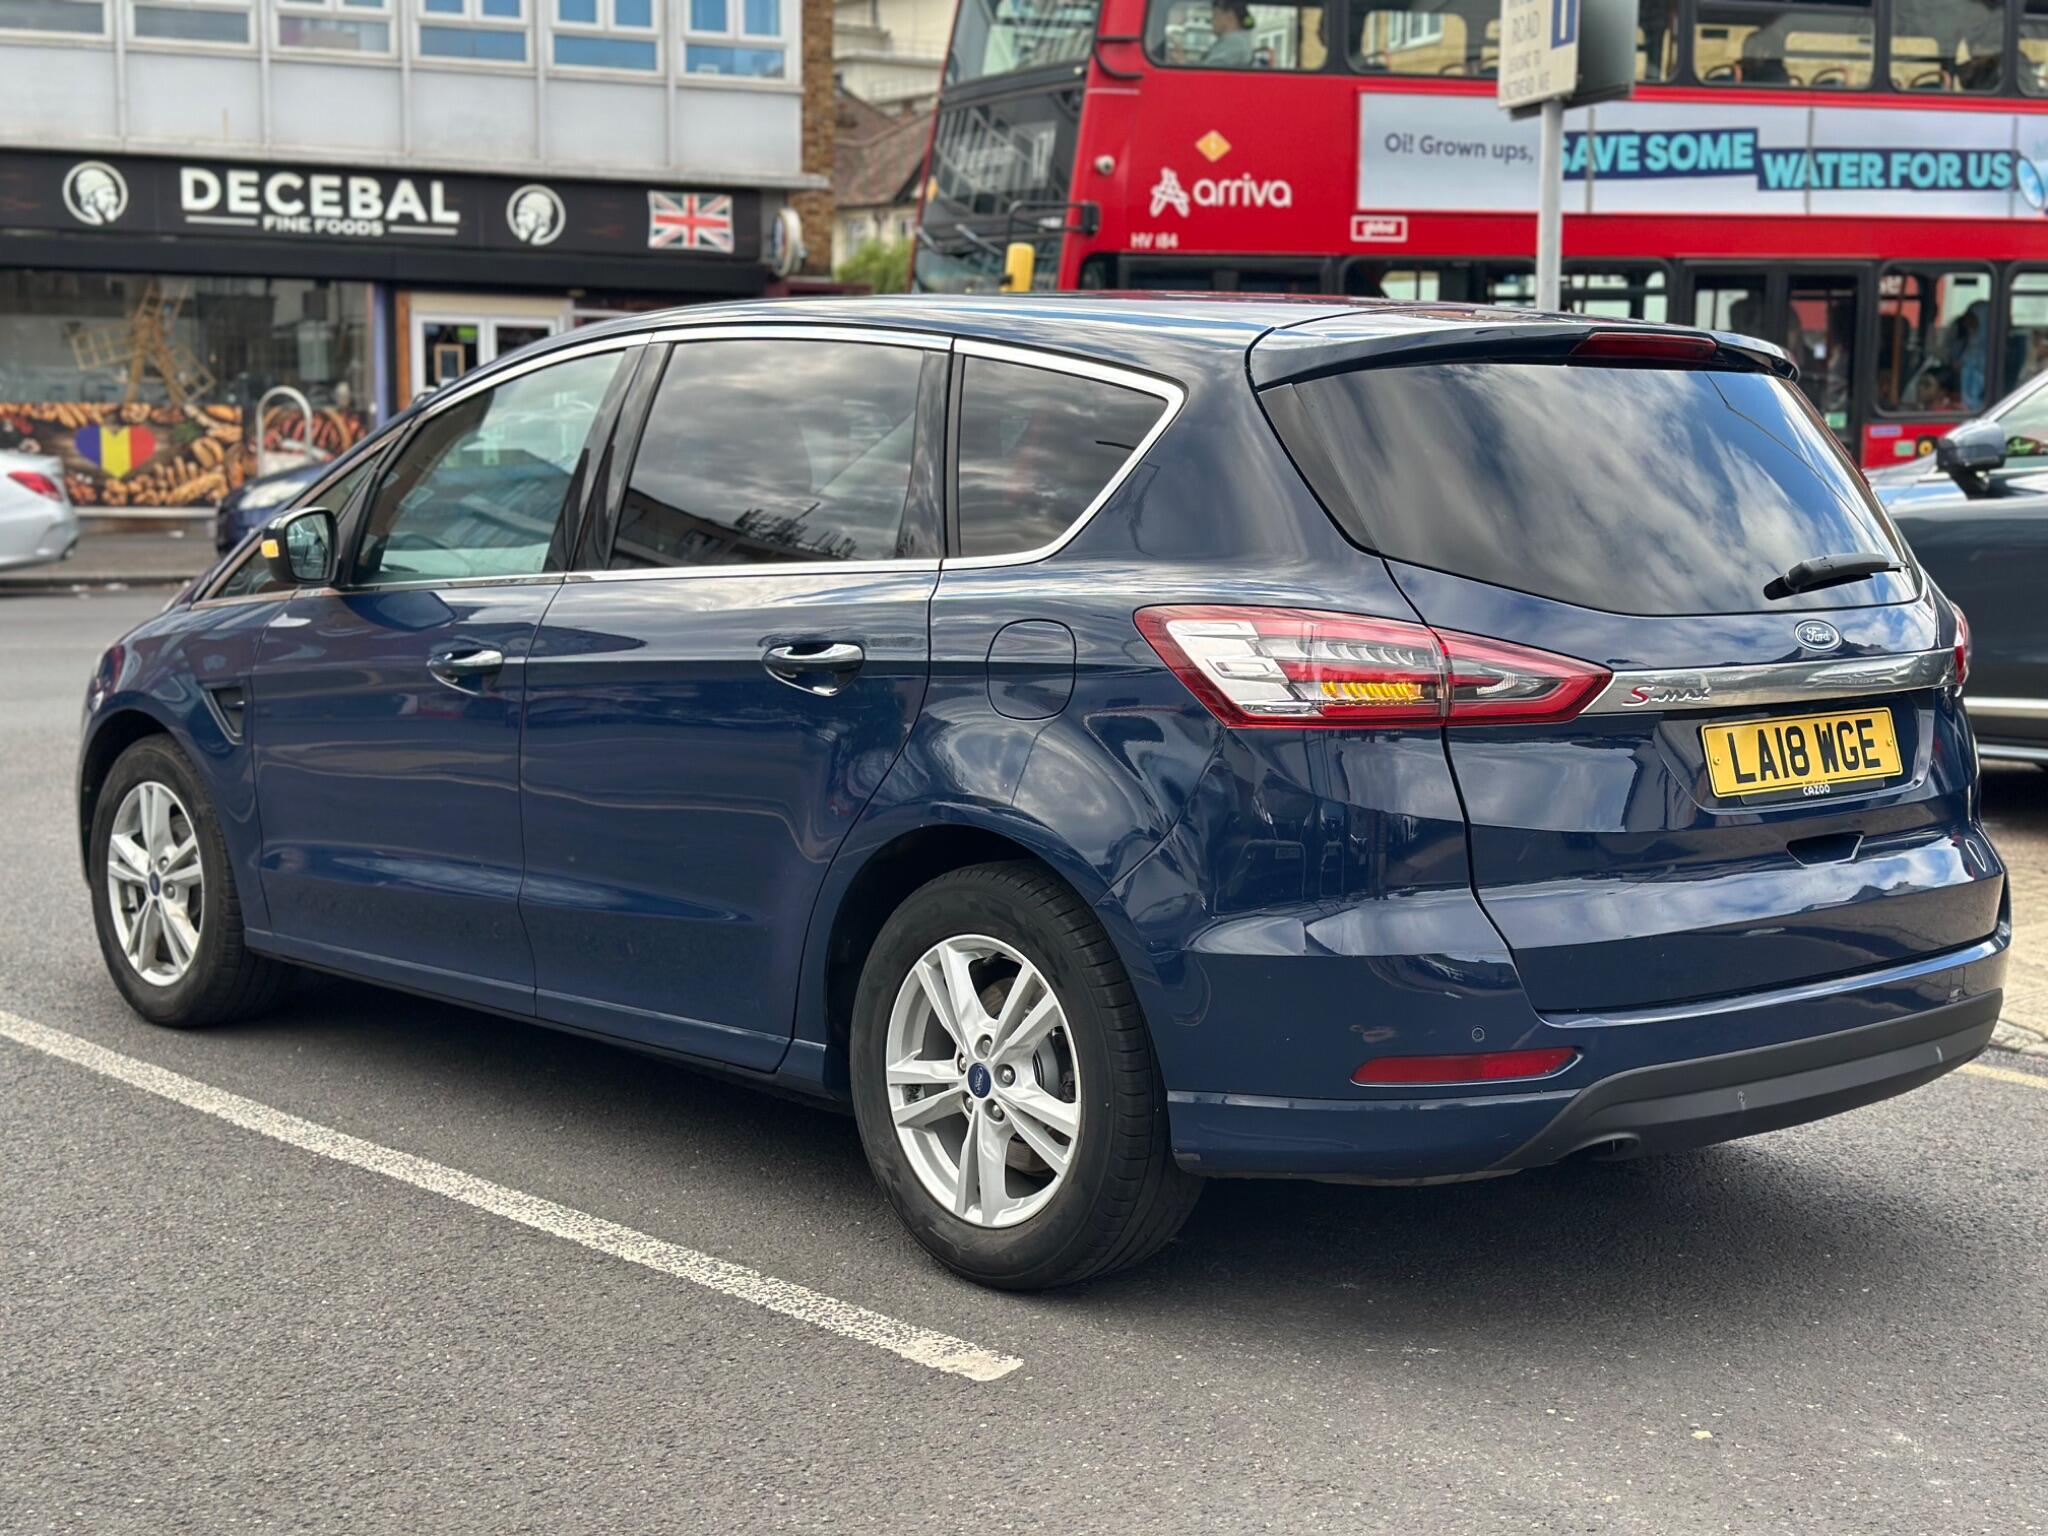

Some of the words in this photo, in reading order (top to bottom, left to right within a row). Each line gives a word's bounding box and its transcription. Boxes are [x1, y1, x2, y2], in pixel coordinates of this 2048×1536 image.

[1385, 133, 1414, 155] Oi!
[1419, 135, 1487, 158] Grown
[1492, 142, 1534, 164] ups,
[1645, 132, 1755, 172] SOME
[1762, 152, 1886, 189] WATER
[1890, 152, 1963, 189] FOR
[1966, 152, 2013, 188] US
[180, 167, 460, 224] DECEBAL
[1193, 173, 1292, 208] arriva
[263, 215, 312, 233] FINE
[315, 217, 384, 237] FOODS
[1130, 232, 1152, 248] HV
[1806, 626, 1831, 642] Ford
[1727, 726, 1810, 784] LA18
[1814, 719, 1881, 774] WGE
[1802, 784, 1831, 796] CAZOO
